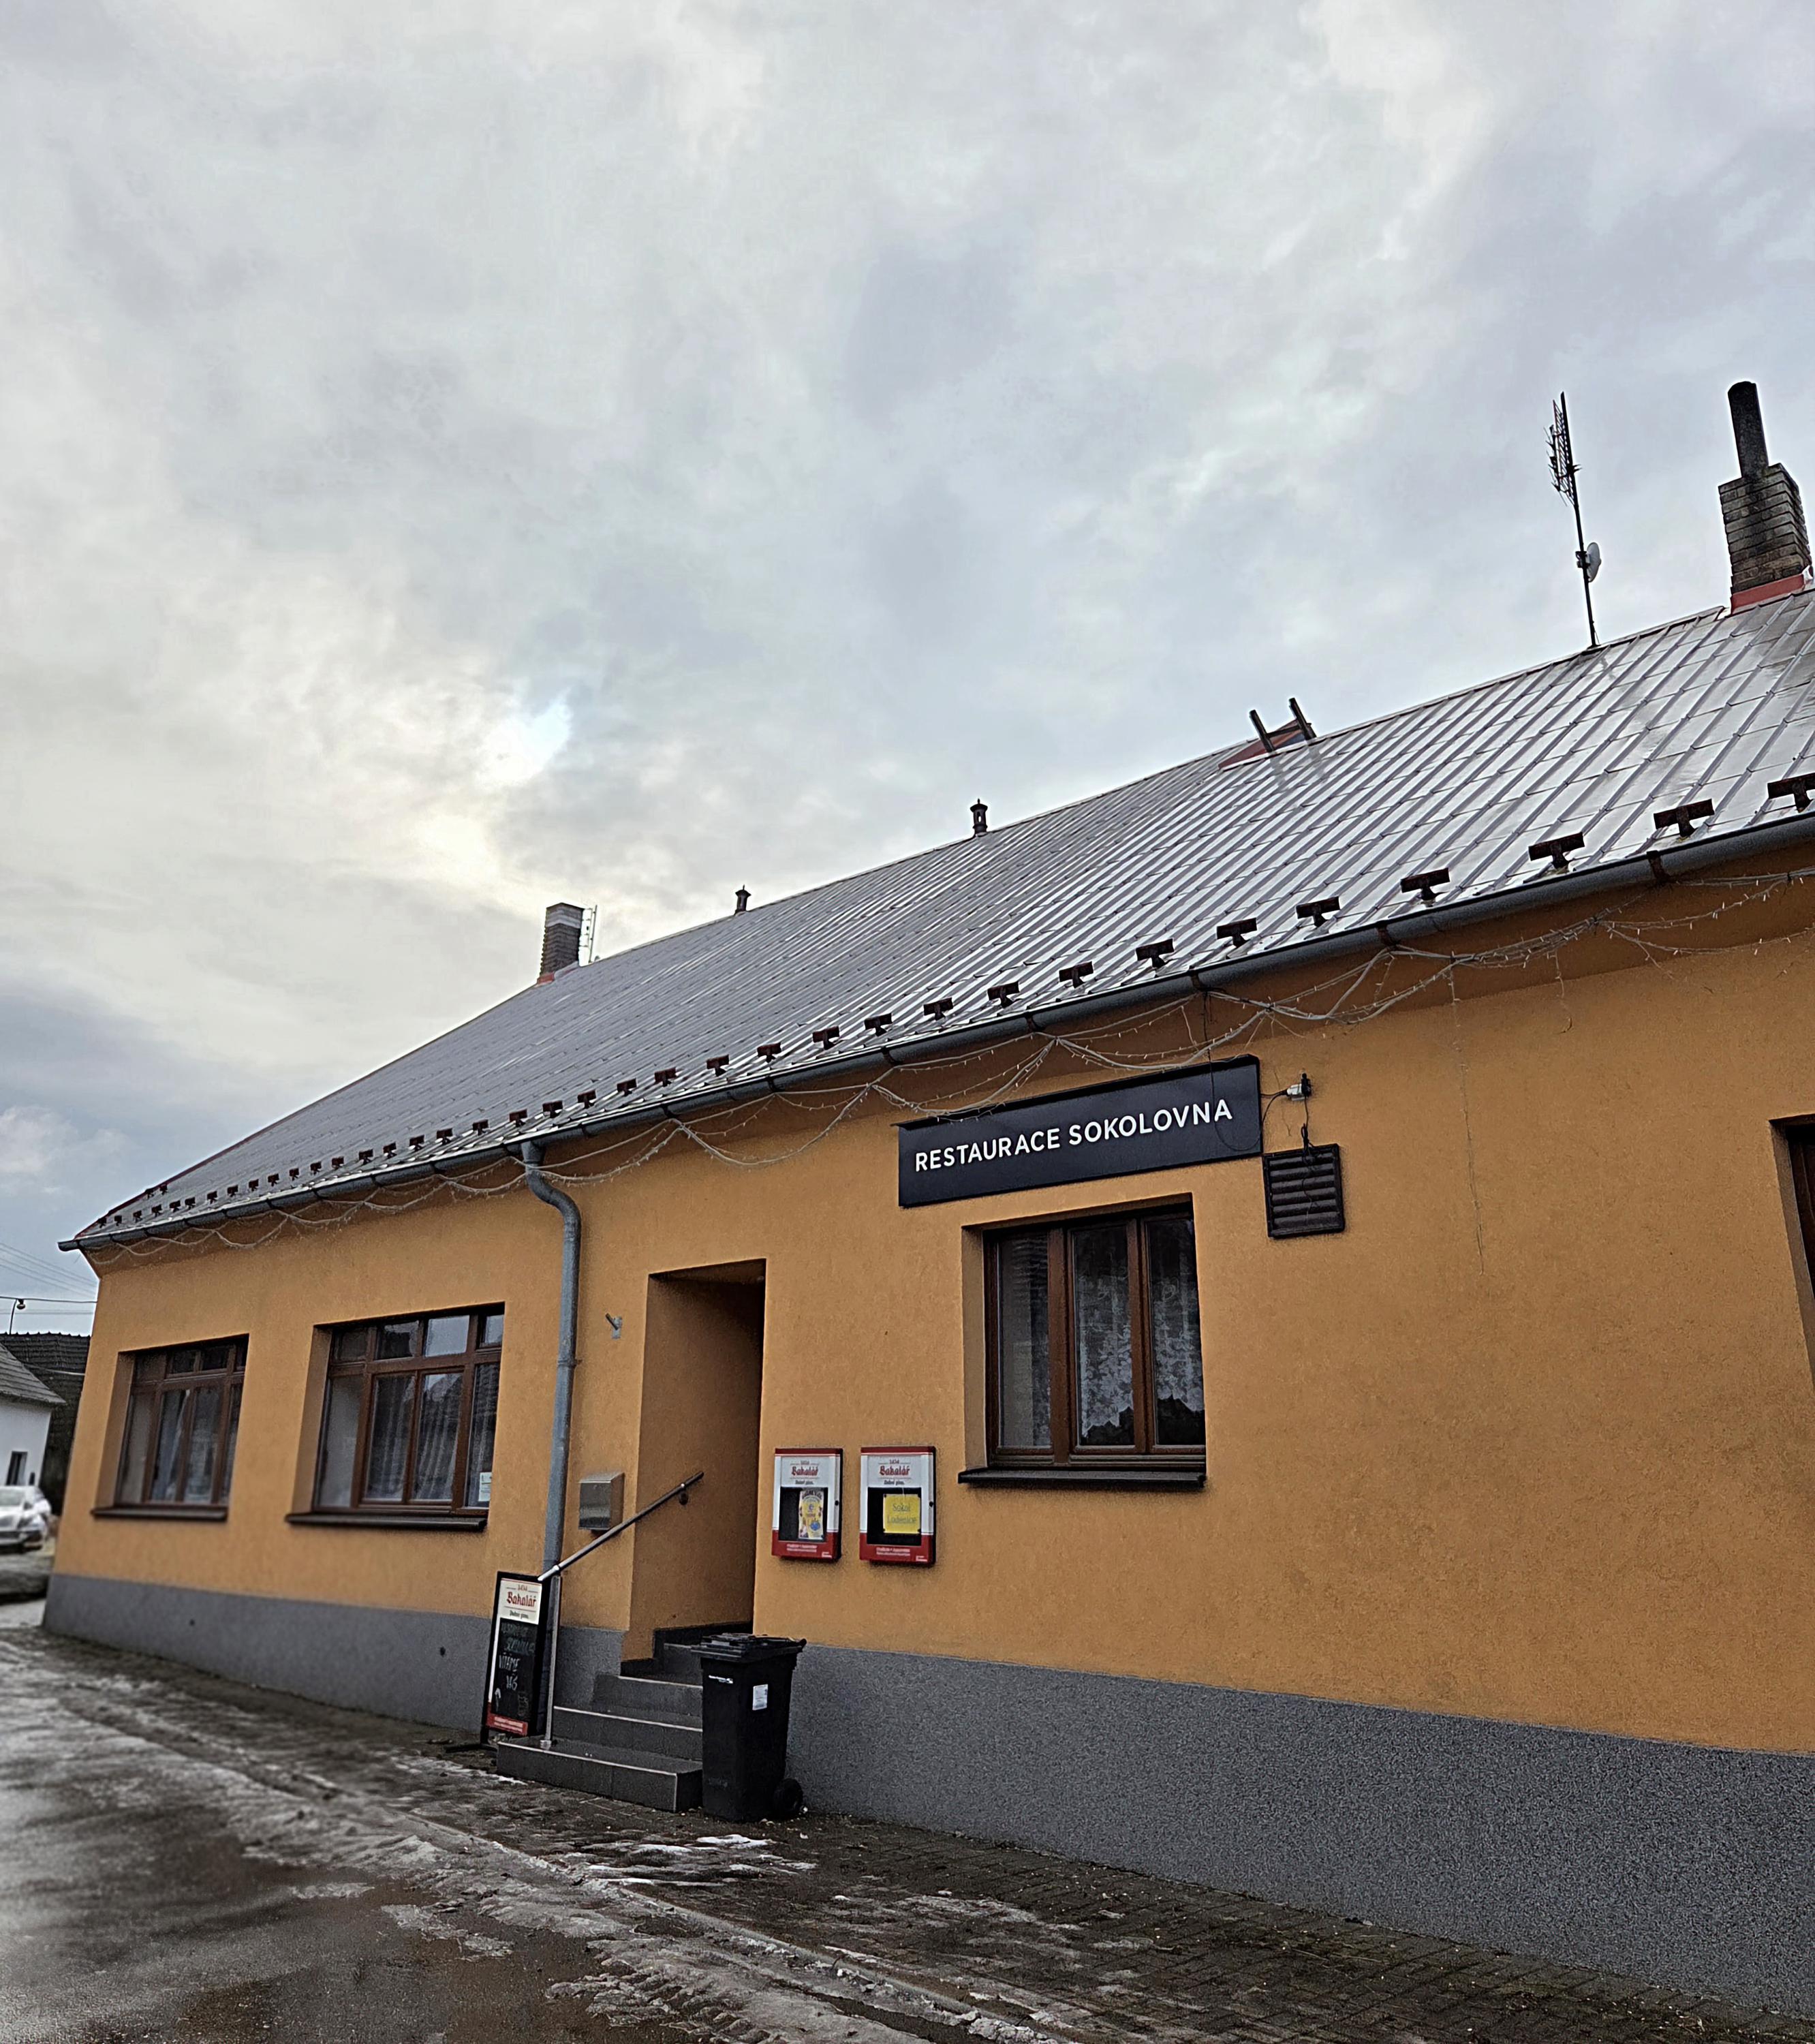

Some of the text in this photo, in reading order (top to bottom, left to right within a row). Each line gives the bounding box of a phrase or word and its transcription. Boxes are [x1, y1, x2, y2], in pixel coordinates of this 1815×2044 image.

[915, 1099, 1233, 1173] RESTAURACE SOKOLOVNA
[879, 1465, 910, 1476] Bakalář
[506, 1591, 537, 1607] Bakalář
